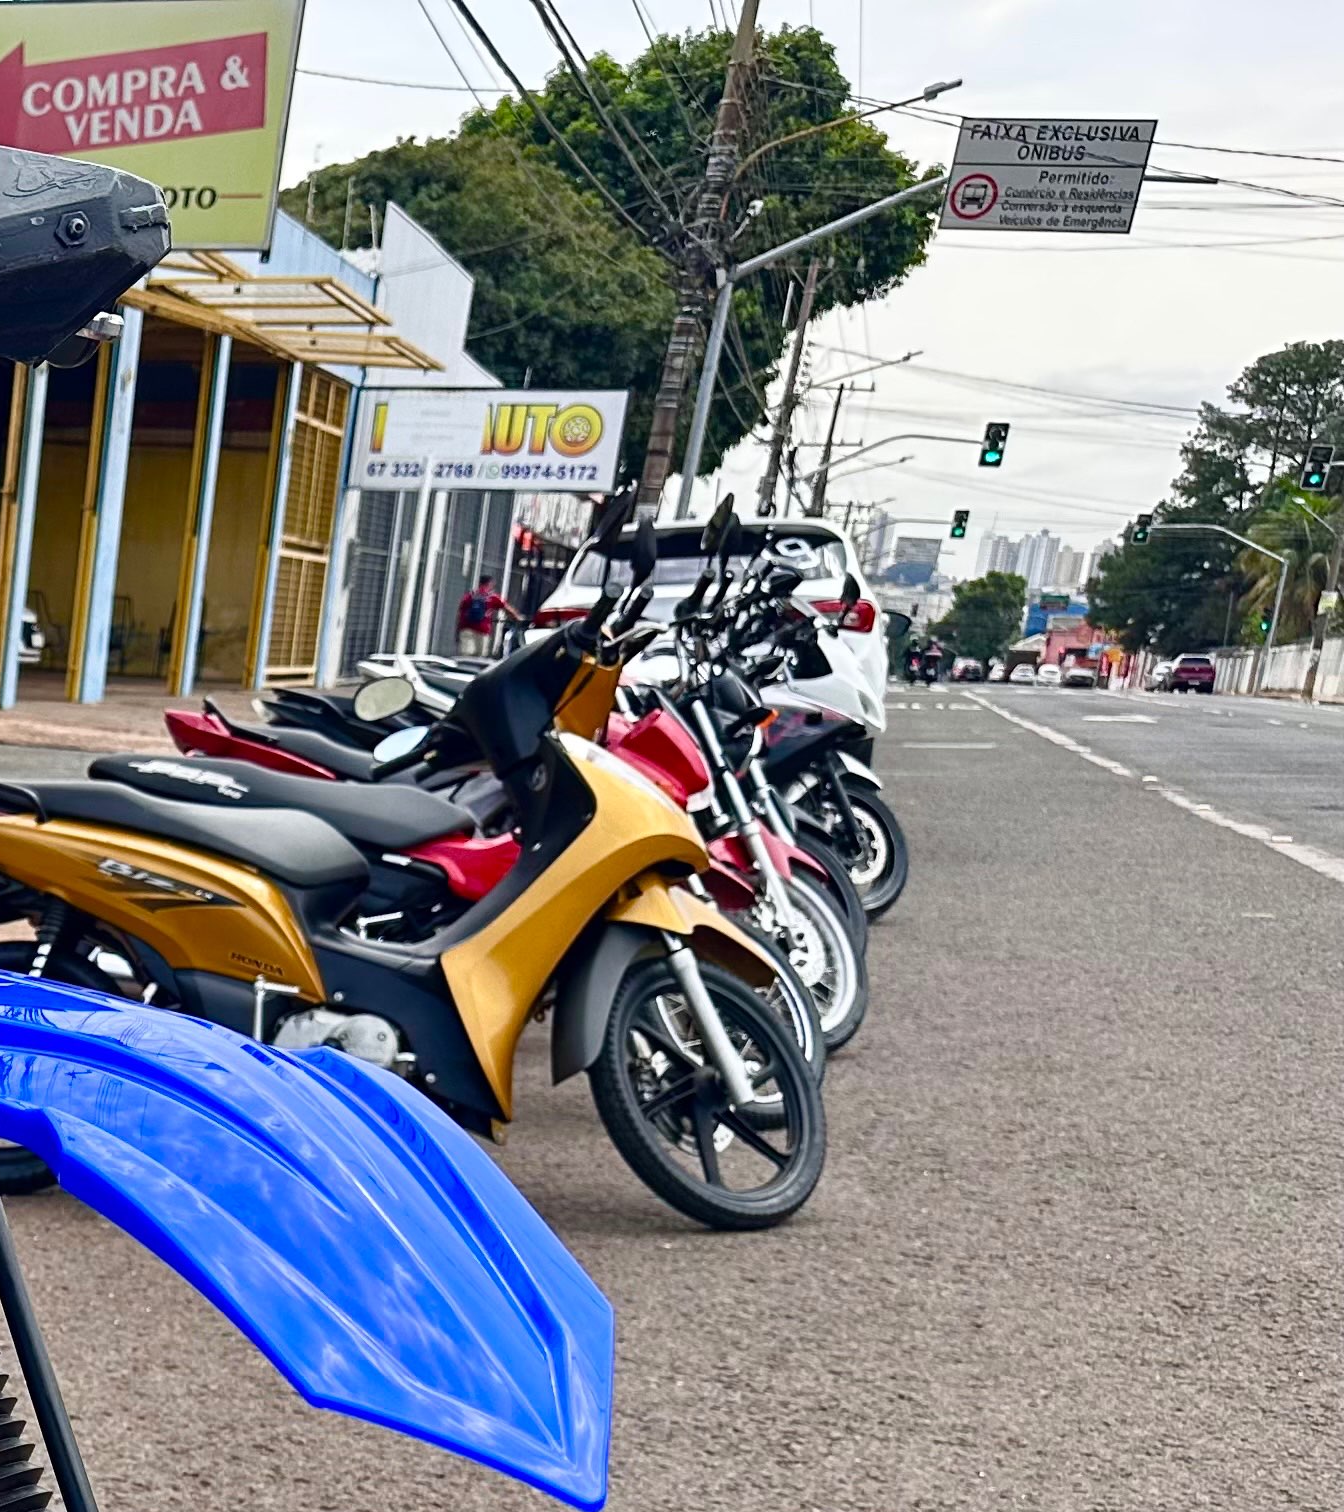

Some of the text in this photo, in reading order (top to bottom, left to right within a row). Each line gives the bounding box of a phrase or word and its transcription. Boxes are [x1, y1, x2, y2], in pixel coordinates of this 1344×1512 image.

[21, 55, 249, 117] COMPRA &
[64, 99, 203, 146] VENDA
[970, 124, 1140, 142] FAIXA EXCLUSIVA
[231, 951, 284, 976] HONDA
